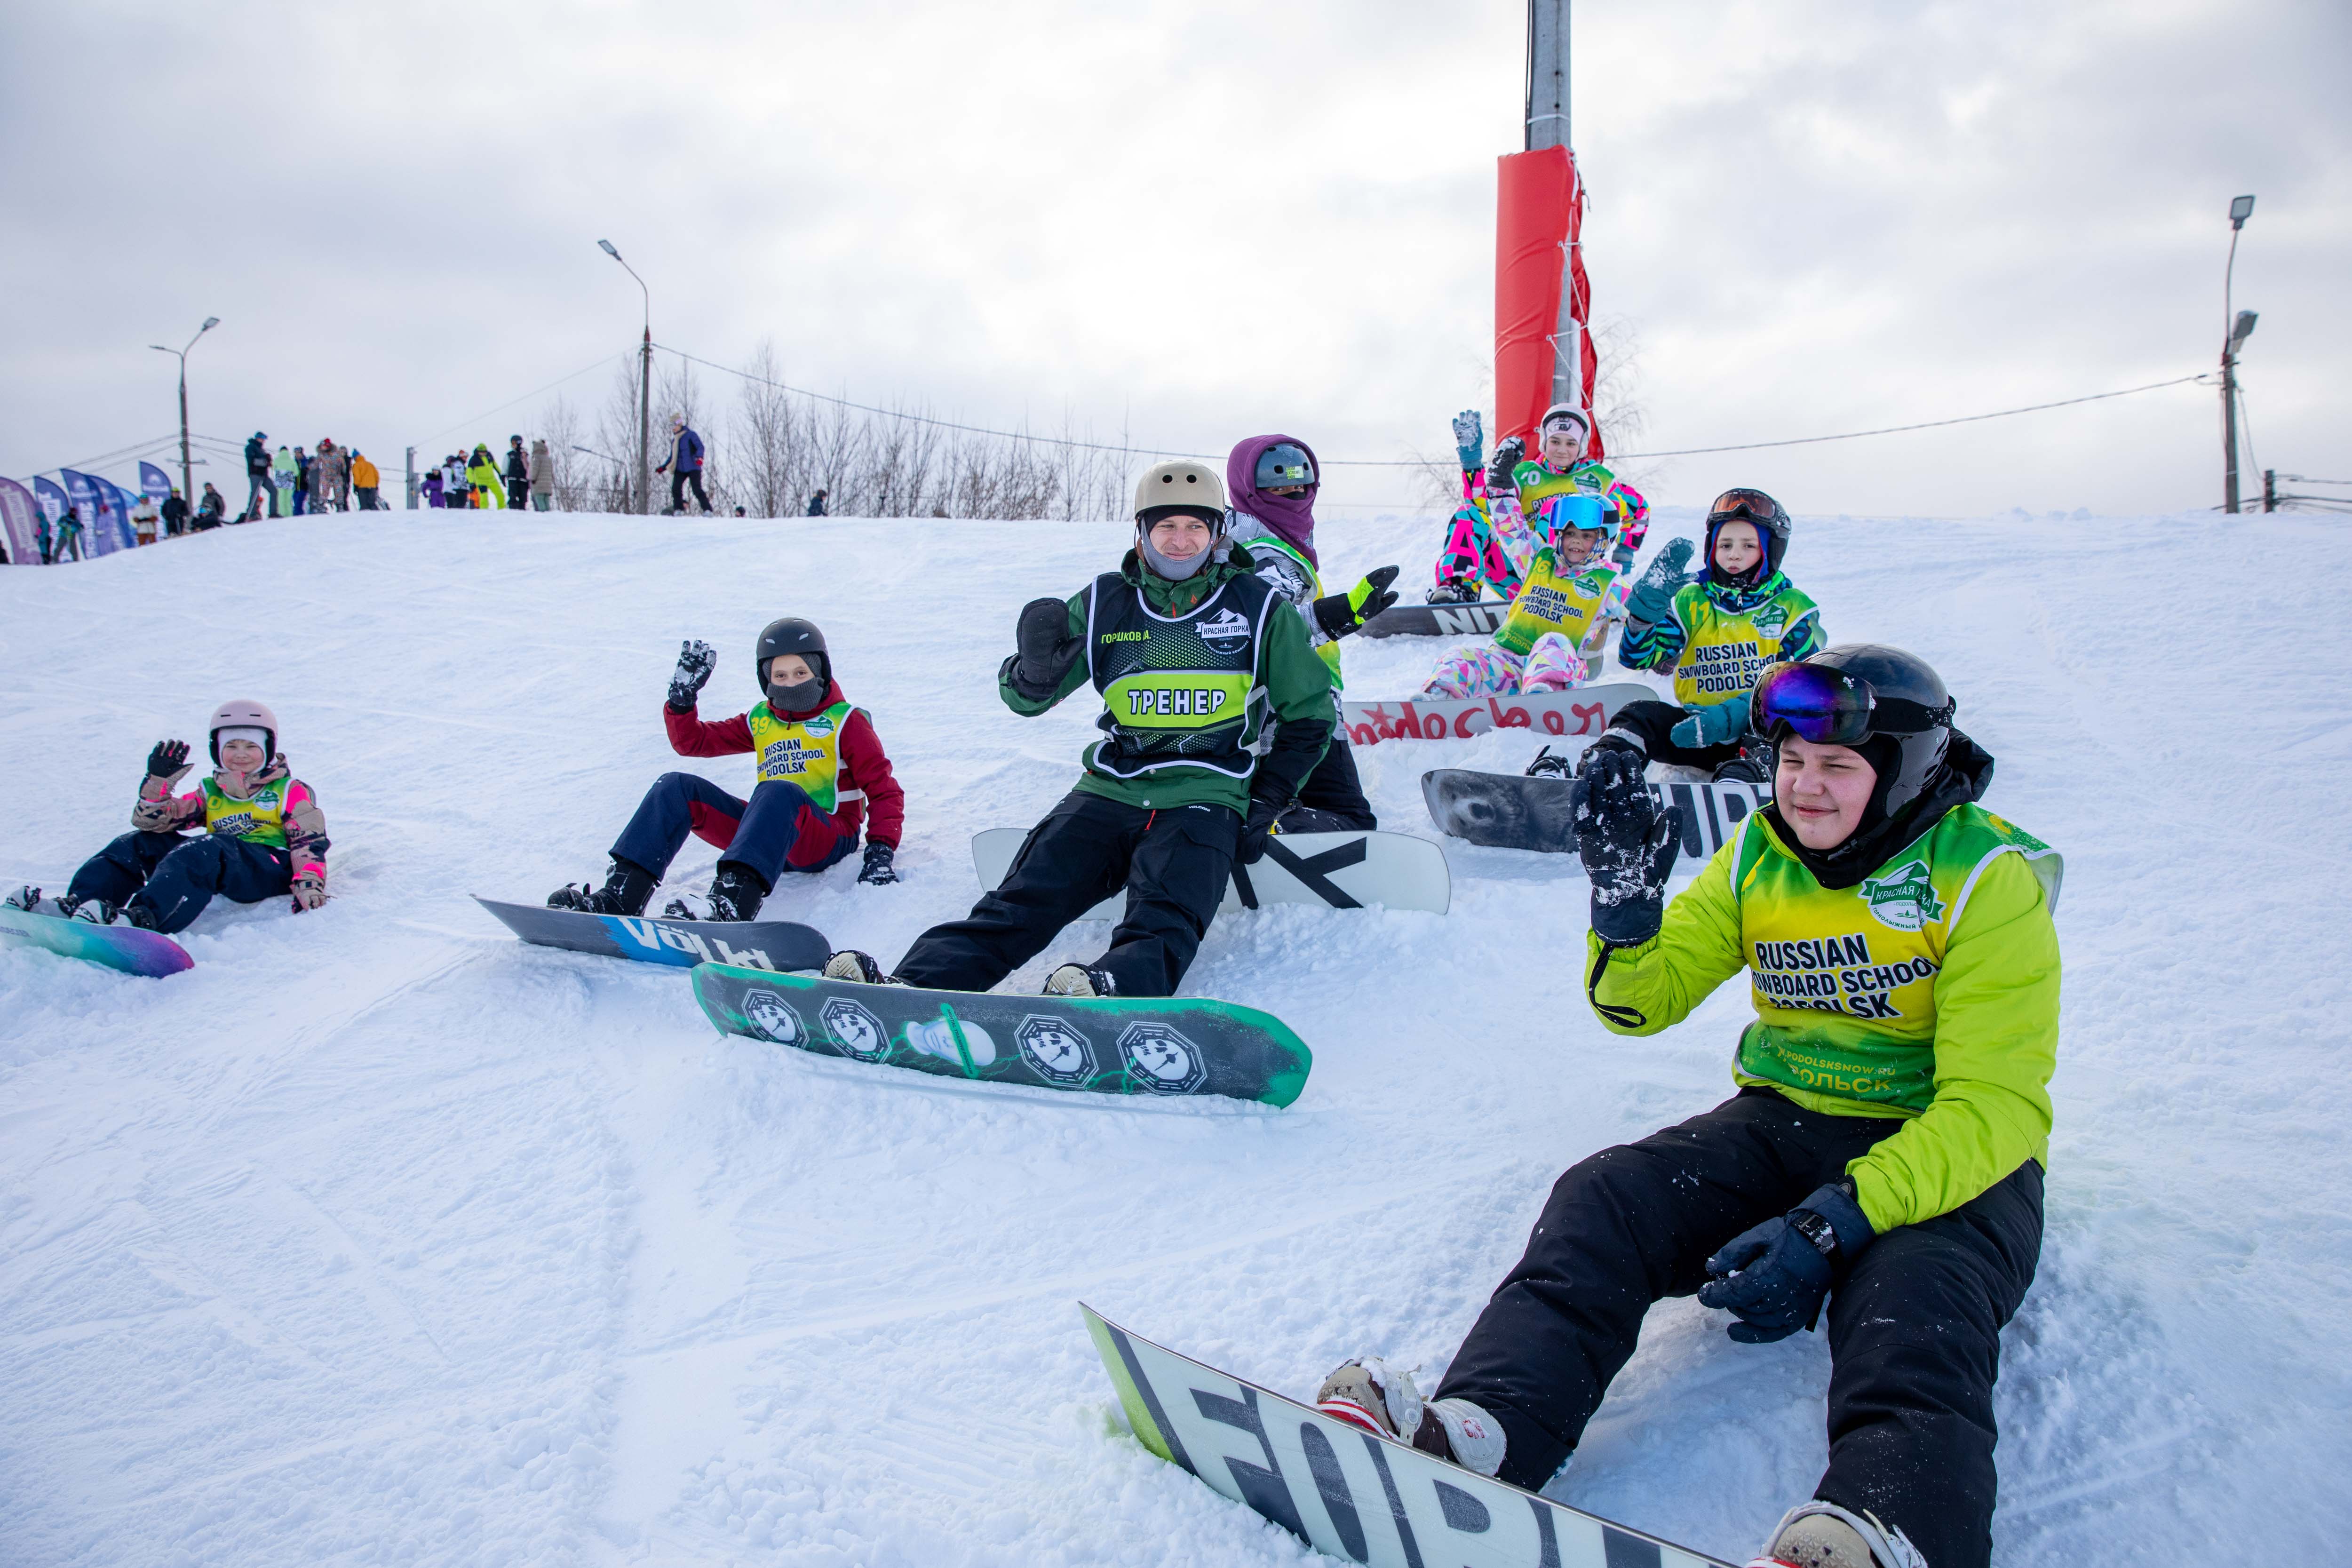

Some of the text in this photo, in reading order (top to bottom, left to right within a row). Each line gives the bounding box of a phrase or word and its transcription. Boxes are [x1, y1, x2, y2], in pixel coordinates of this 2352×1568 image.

[1523, 604, 1563, 624] PODOLSK
[1553, 603, 1583, 619] SCHOOL
[1689, 601, 1710, 625] 11
[1101, 631, 1142, 644] ГОРШКОВ
[1204, 627, 1229, 635] КРАСНАЯ
[1695, 642, 1758, 663] RUSSIAN
[1678, 654, 1777, 679] SNOWBOARD SCHO
[1128, 690, 1226, 715] ТРЕНЕР
[764, 739, 801, 758] RUSSIAN
[757, 749, 826, 774] SNOWBOARD SCHOOL
[207, 793, 222, 810] 0
[212, 812, 252, 829] RUSSIAN
[1875, 885, 1915, 901] КРАСНАЯ
[1873, 907, 1916, 929] ГОРНОЛЫЖНЫЙ
[1755, 934, 1870, 971] RUSSIAN
[1751, 969, 1837, 996] OWBOARD
[947, 1009, 973, 1075] MENTAL TRAINING PROGRAM
[1789, 1063, 1892, 1093] ОЛЬСК
